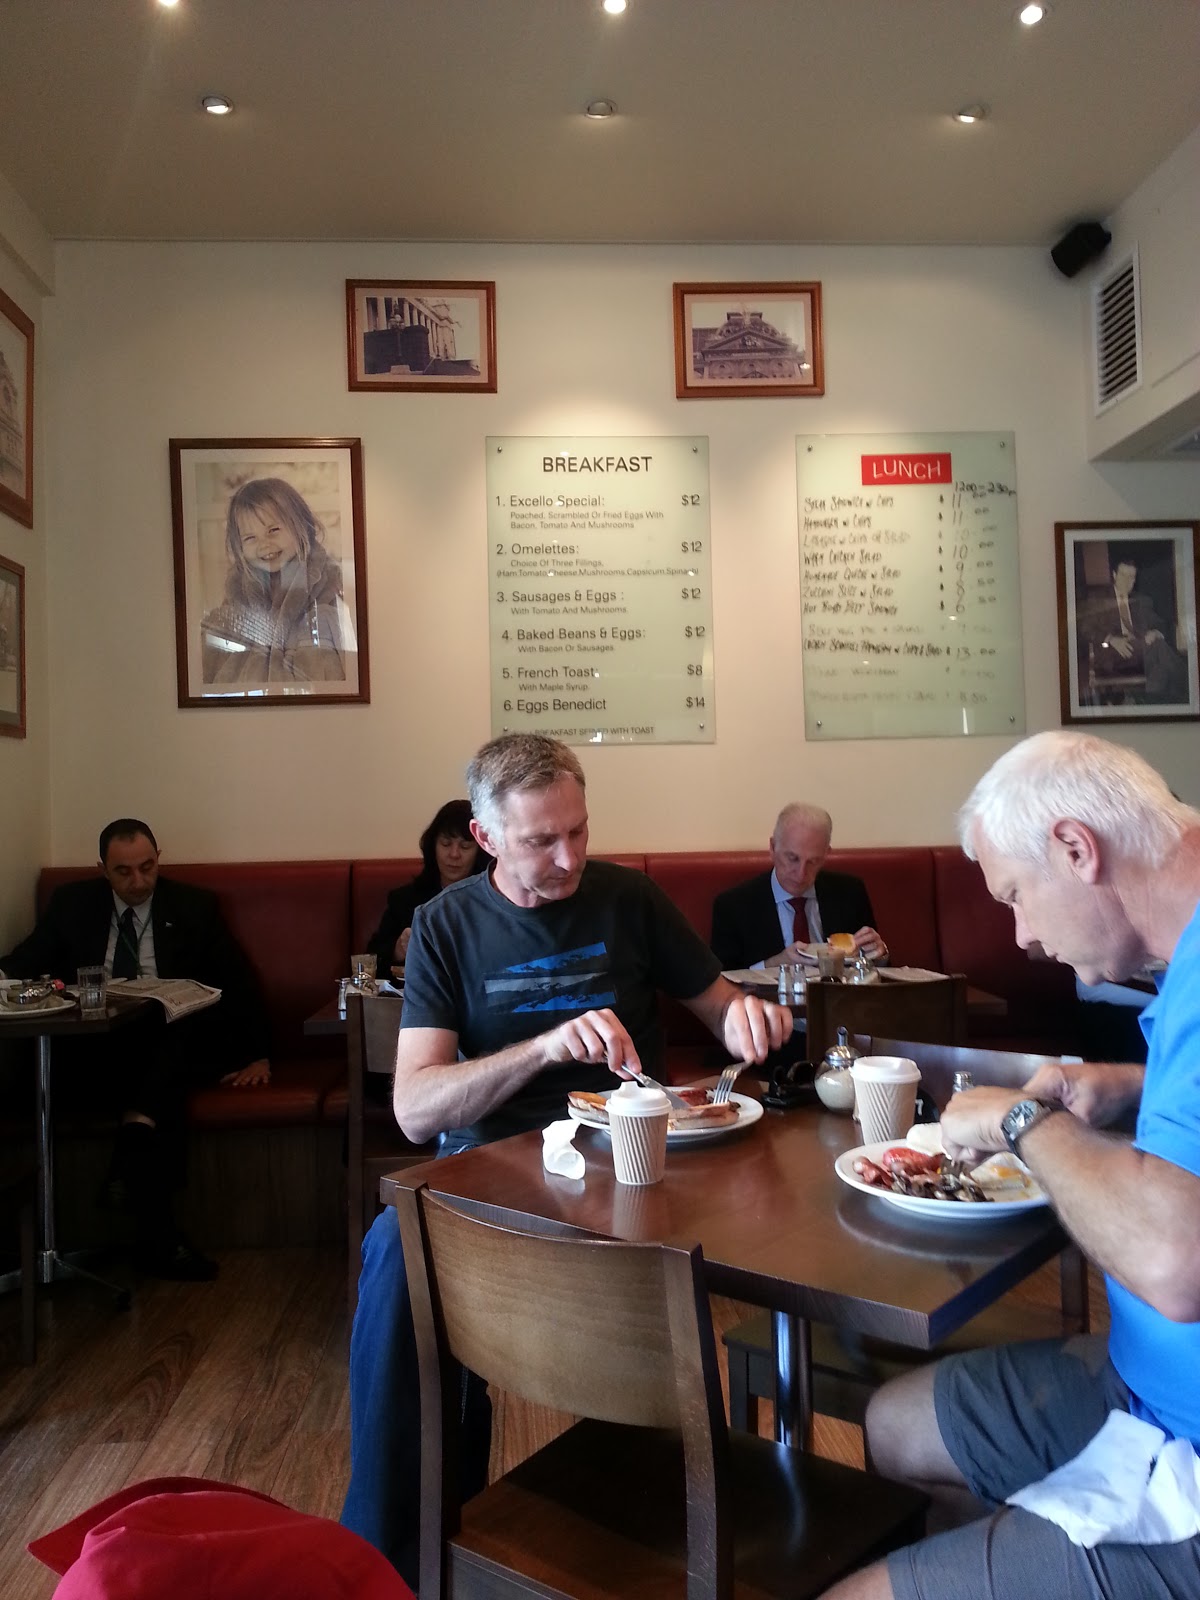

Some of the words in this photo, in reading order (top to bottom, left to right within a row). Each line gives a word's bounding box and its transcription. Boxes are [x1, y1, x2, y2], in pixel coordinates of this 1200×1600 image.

[542, 456, 653, 473] BREAKFAST
[872, 459, 941, 480] LUNCH
[510, 494, 554, 507] Excello
[557, 494, 605, 509] Special:
[681, 494, 701, 507] $12
[548, 511, 590, 520] Scrambled
[591, 511, 601, 520] Or
[603, 511, 622, 519] Fried
[624, 511, 644, 521] Eggs
[645, 511, 664, 519] With
[540, 521, 568, 530] Tomato
[570, 521, 586, 529] And
[588, 520, 634, 529] Mushrooms
[496, 543, 508, 555] 2.
[511, 542, 580, 555] Omelettes:
[681, 540, 702, 554] $12
[510, 559, 537, 568] Choice
[540, 559, 549, 567] Of
[551, 559, 574, 567] Three
[496, 591, 508, 603] 3.
[512, 590, 571, 604] Sausages
[574, 589, 582, 601] &
[681, 587, 701, 600] $12
[511, 607, 530, 616] With
[532, 606, 561, 615] Tomato
[562, 606, 579, 614] And
[502, 629, 513, 641] 4.
[517, 628, 555, 640] Baked
[559, 627, 597, 639] Beans
[600, 627, 608, 639] &
[611, 626, 647, 641] Eggs:
[685, 625, 705, 638] $12
[518, 645, 536, 653] With
[539, 644, 563, 653] Bacon
[565, 644, 575, 652] Or
[502, 667, 513, 680] 5.
[517, 666, 558, 678] French
[687, 664, 703, 677] $8
[519, 683, 538, 691] With
[540, 683, 564, 693] Maple
[503, 699, 514, 712] 6.
[517, 699, 549, 714] Eggs
[552, 698, 607, 711] Benedict
[686, 696, 705, 709] $14
[610, 726, 629, 735] WITH
[631, 725, 655, 735] TOAST
